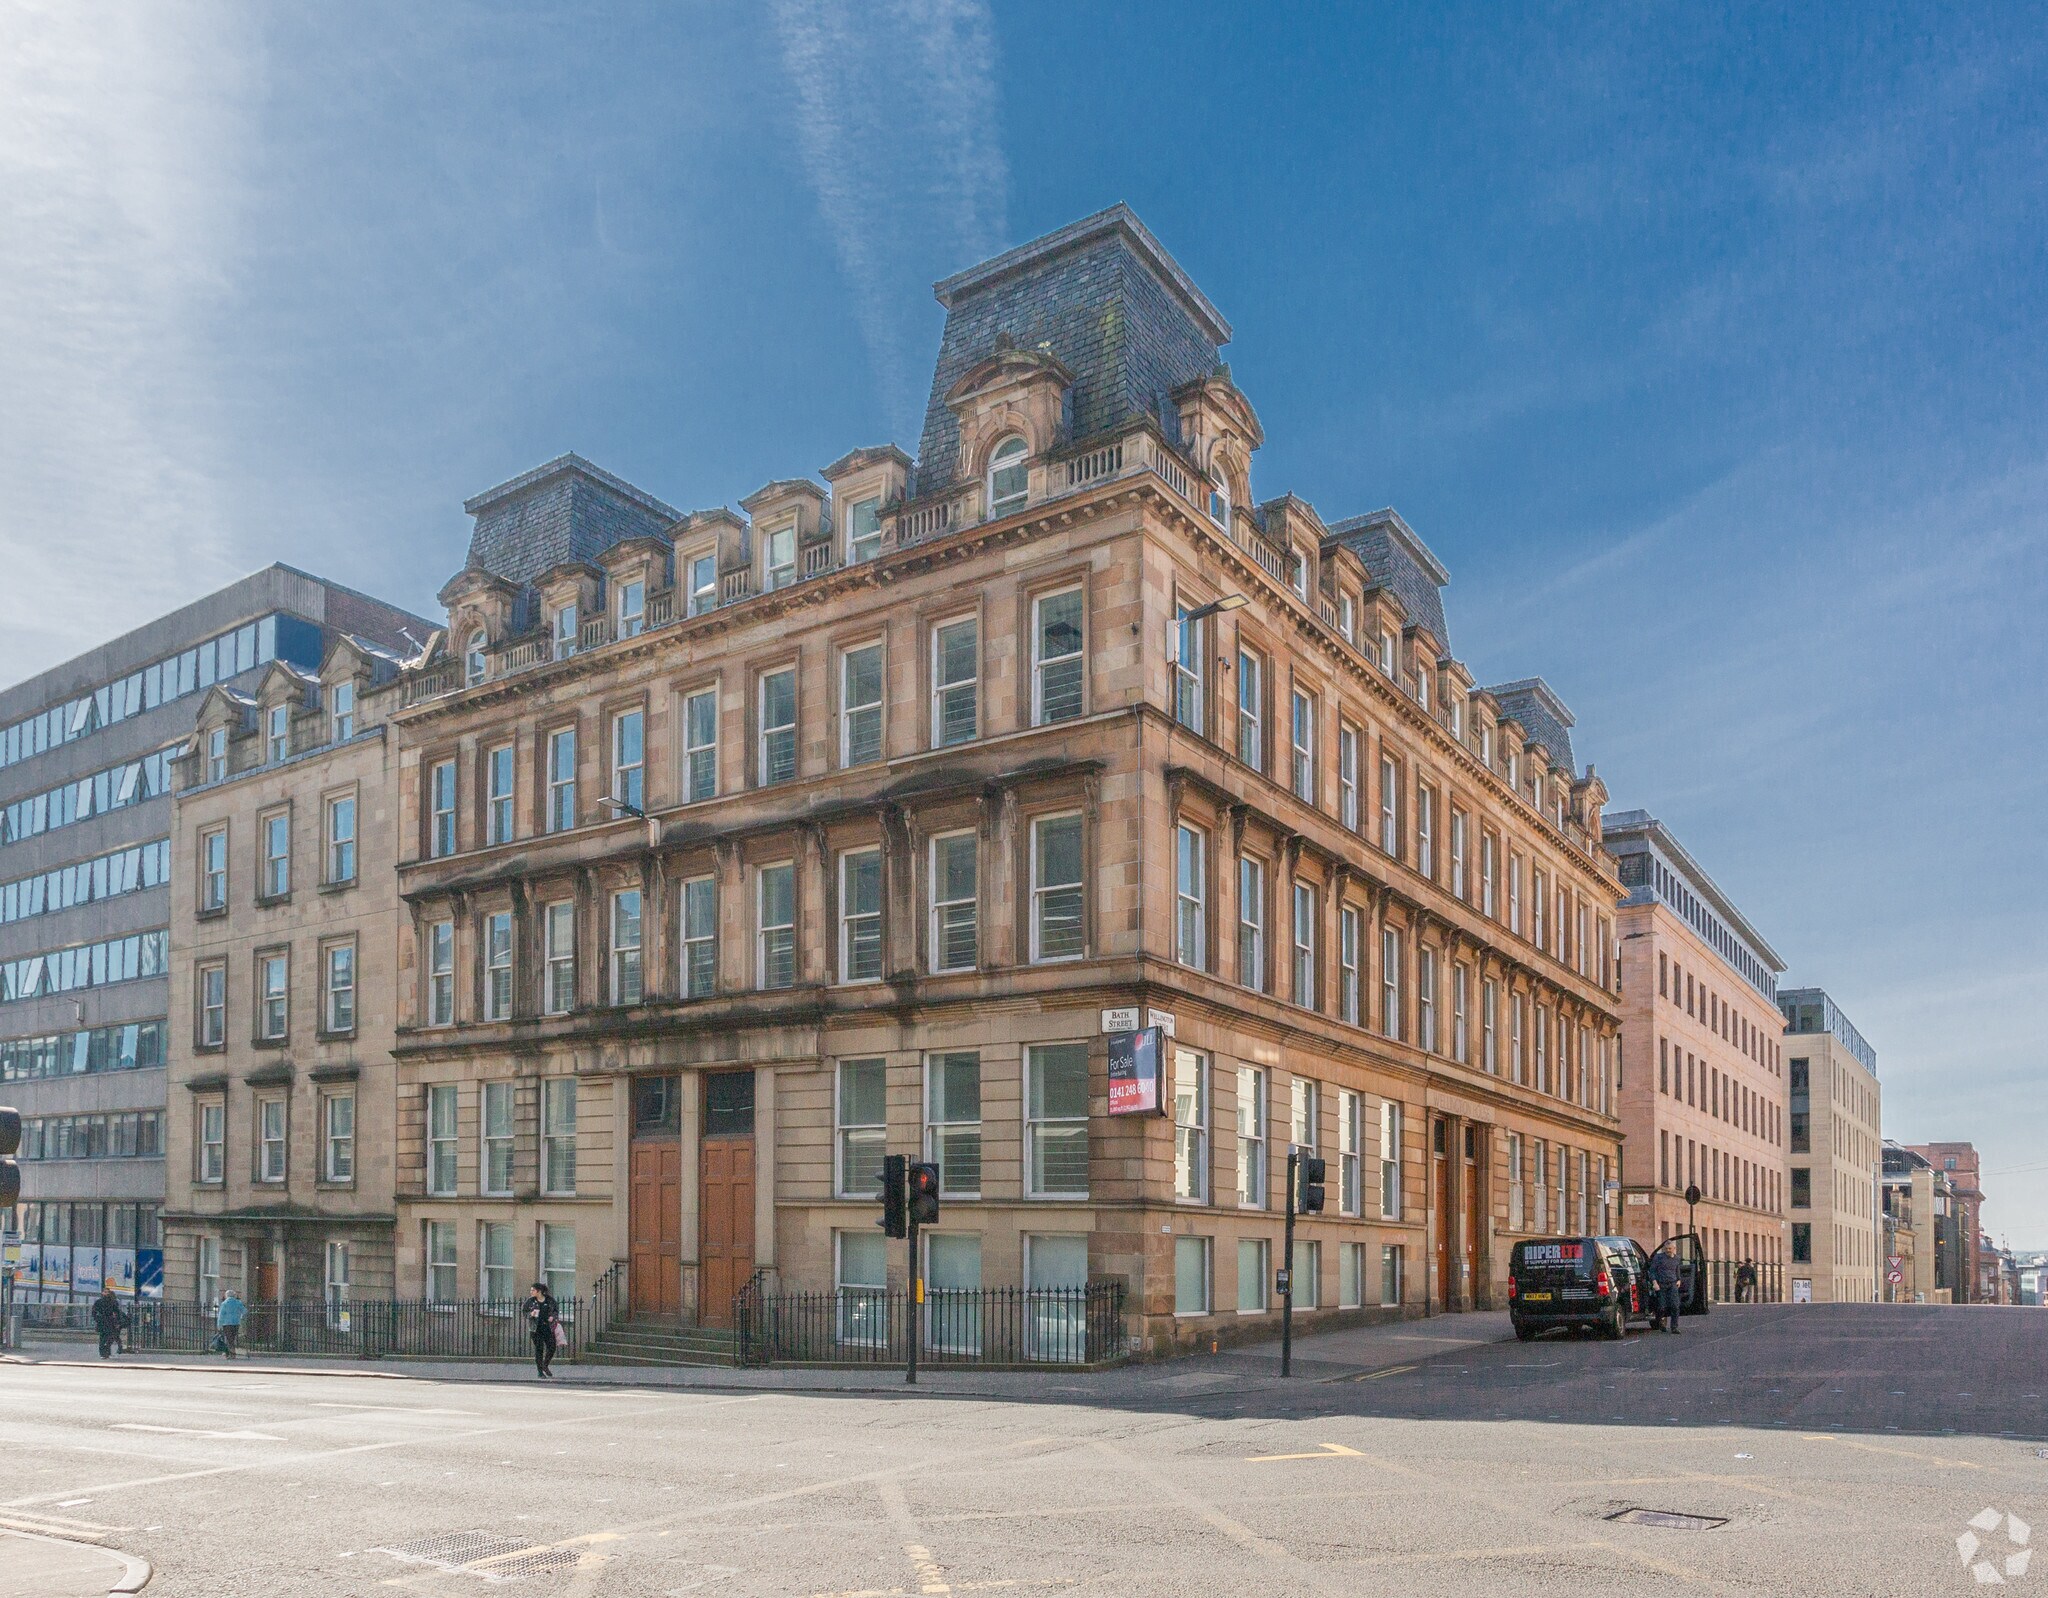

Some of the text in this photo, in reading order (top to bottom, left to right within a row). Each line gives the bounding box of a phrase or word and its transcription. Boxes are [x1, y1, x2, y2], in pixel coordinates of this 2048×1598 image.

[1109, 1020, 1132, 1028] STREET
[1142, 1034, 1154, 1047] JLL
[1110, 1054, 1133, 1070] For Sale
[1110, 1086, 1124, 1099] 0141
